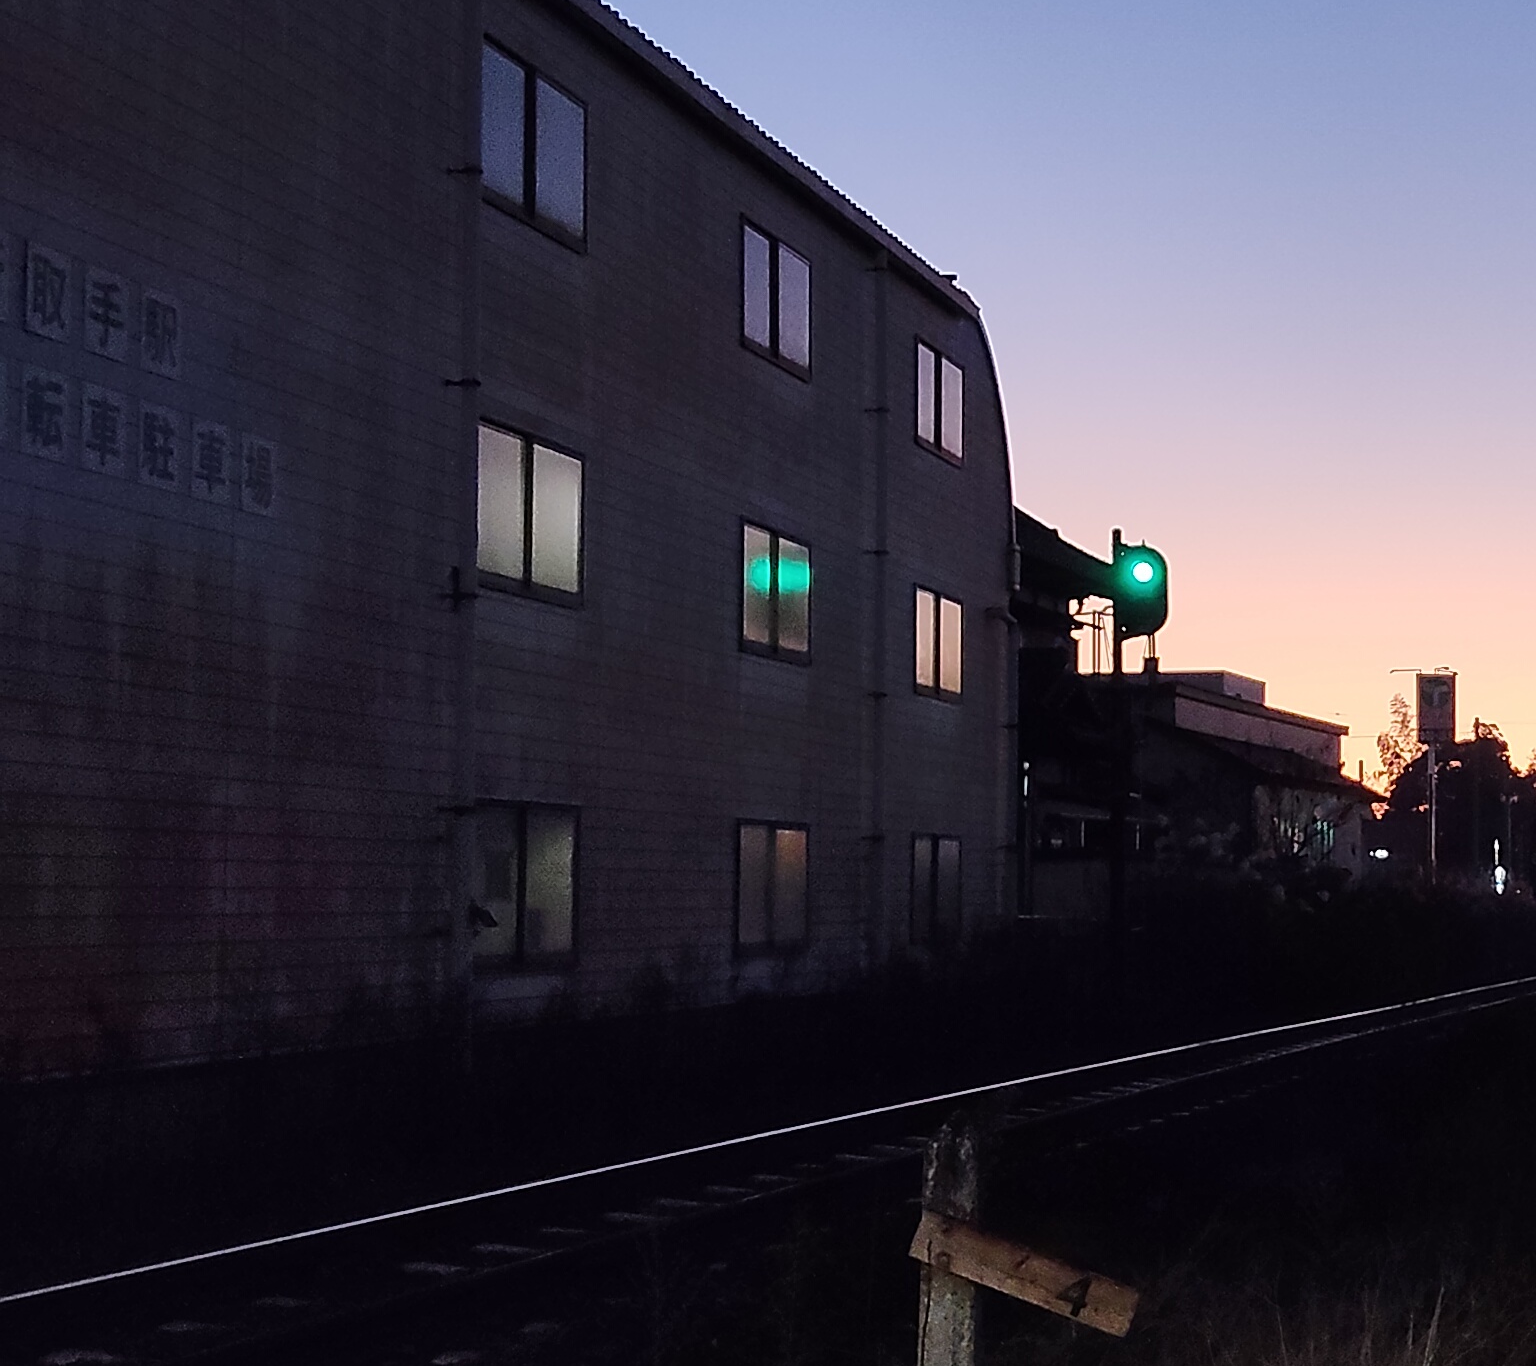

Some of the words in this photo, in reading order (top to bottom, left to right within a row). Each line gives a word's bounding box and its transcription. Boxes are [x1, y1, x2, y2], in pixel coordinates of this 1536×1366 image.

[0, 247, 178, 368] 取手駅
[1056, 1273, 1092, 1317] 4
